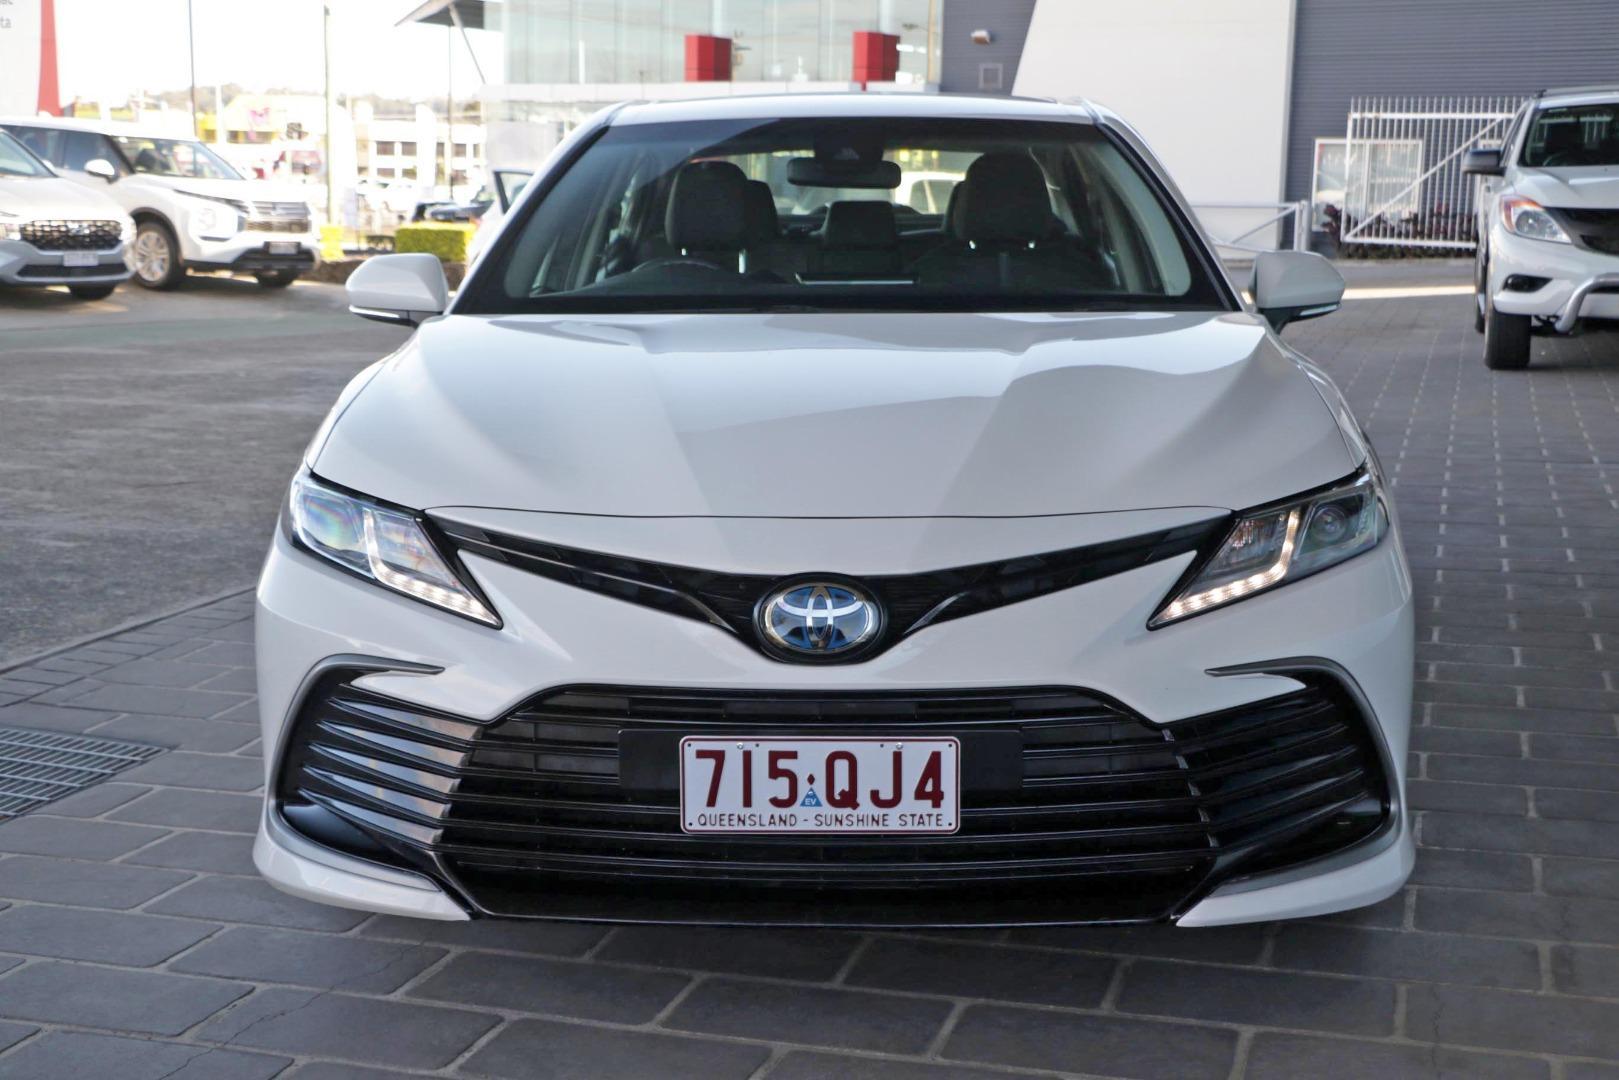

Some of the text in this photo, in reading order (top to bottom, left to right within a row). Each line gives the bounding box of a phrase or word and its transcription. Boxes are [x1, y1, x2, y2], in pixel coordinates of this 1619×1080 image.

[804, 798, 816, 806] EV
[697, 813, 797, 827] QUEENSLAND
[814, 813, 889, 827] SUNSHINE
[898, 813, 944, 827] STATE
